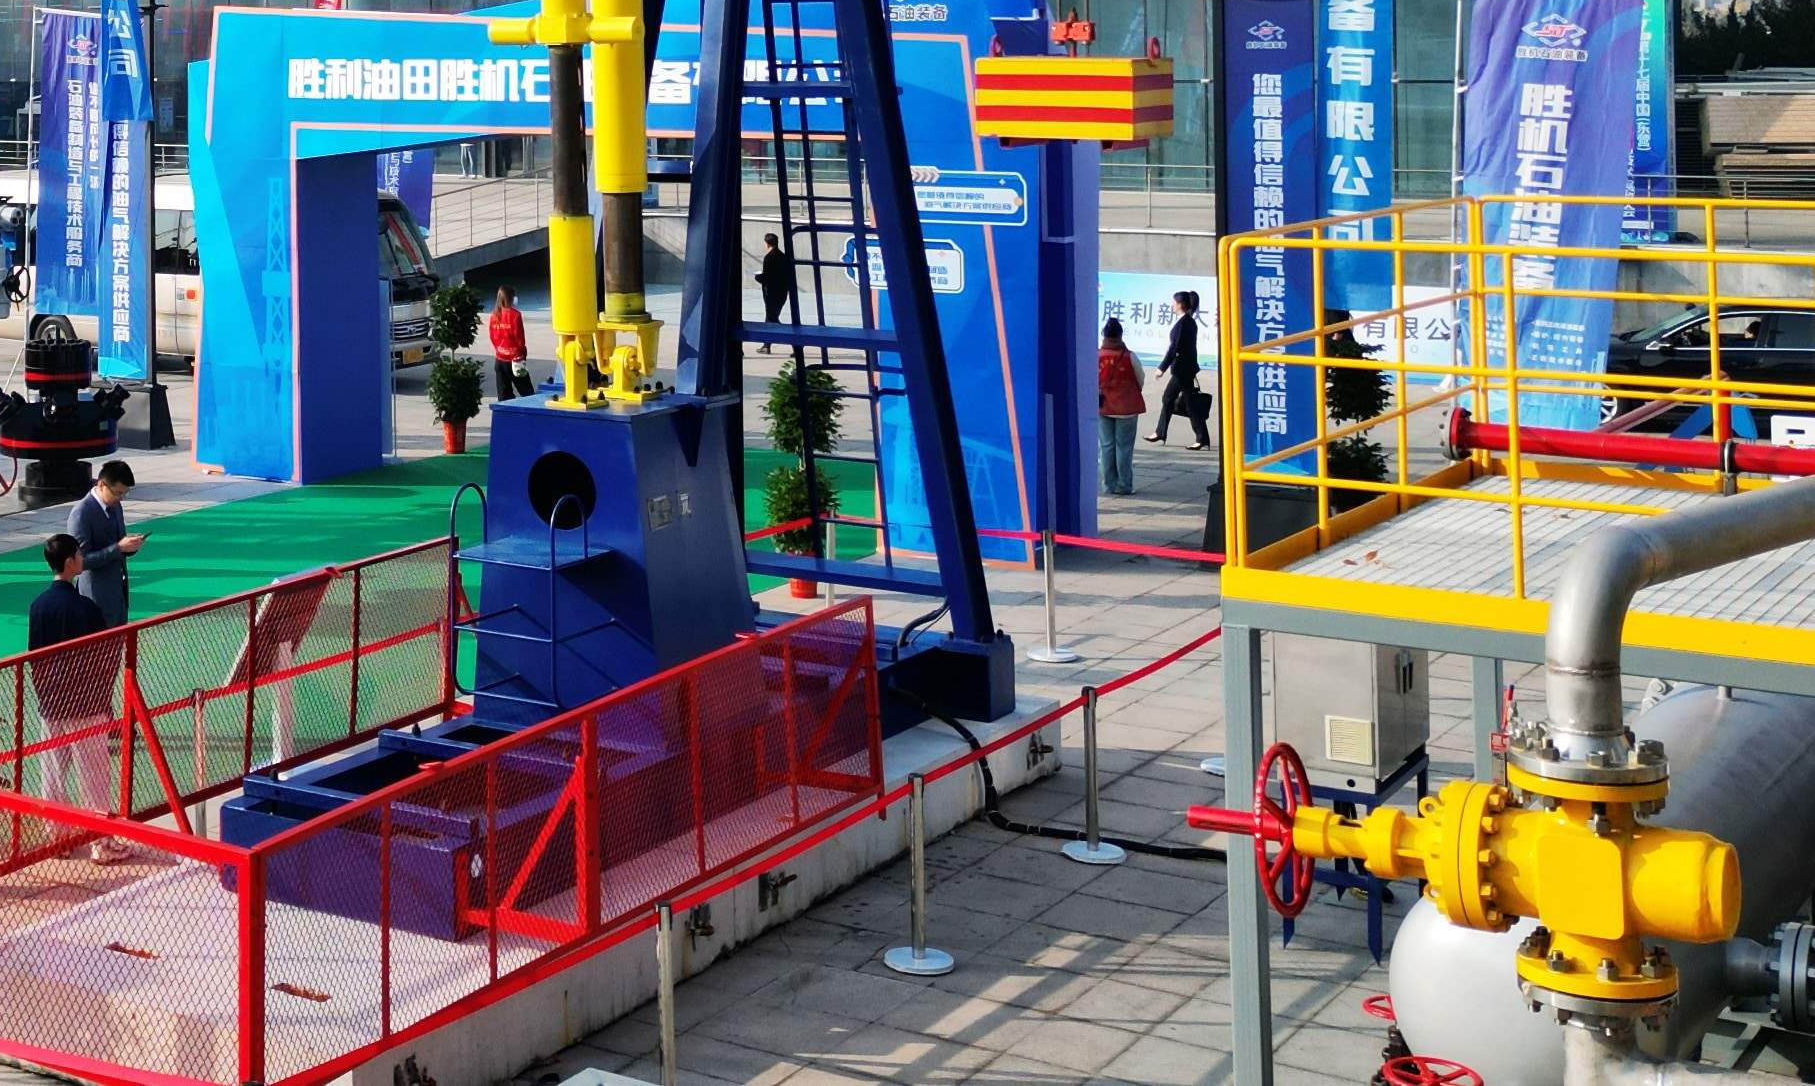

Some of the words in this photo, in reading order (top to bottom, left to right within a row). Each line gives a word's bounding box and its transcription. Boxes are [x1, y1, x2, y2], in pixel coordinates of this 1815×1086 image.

[889, 4, 948, 21] 石油装备
[111, 120, 130, 343] 得信赖的油气解决方案供应商
